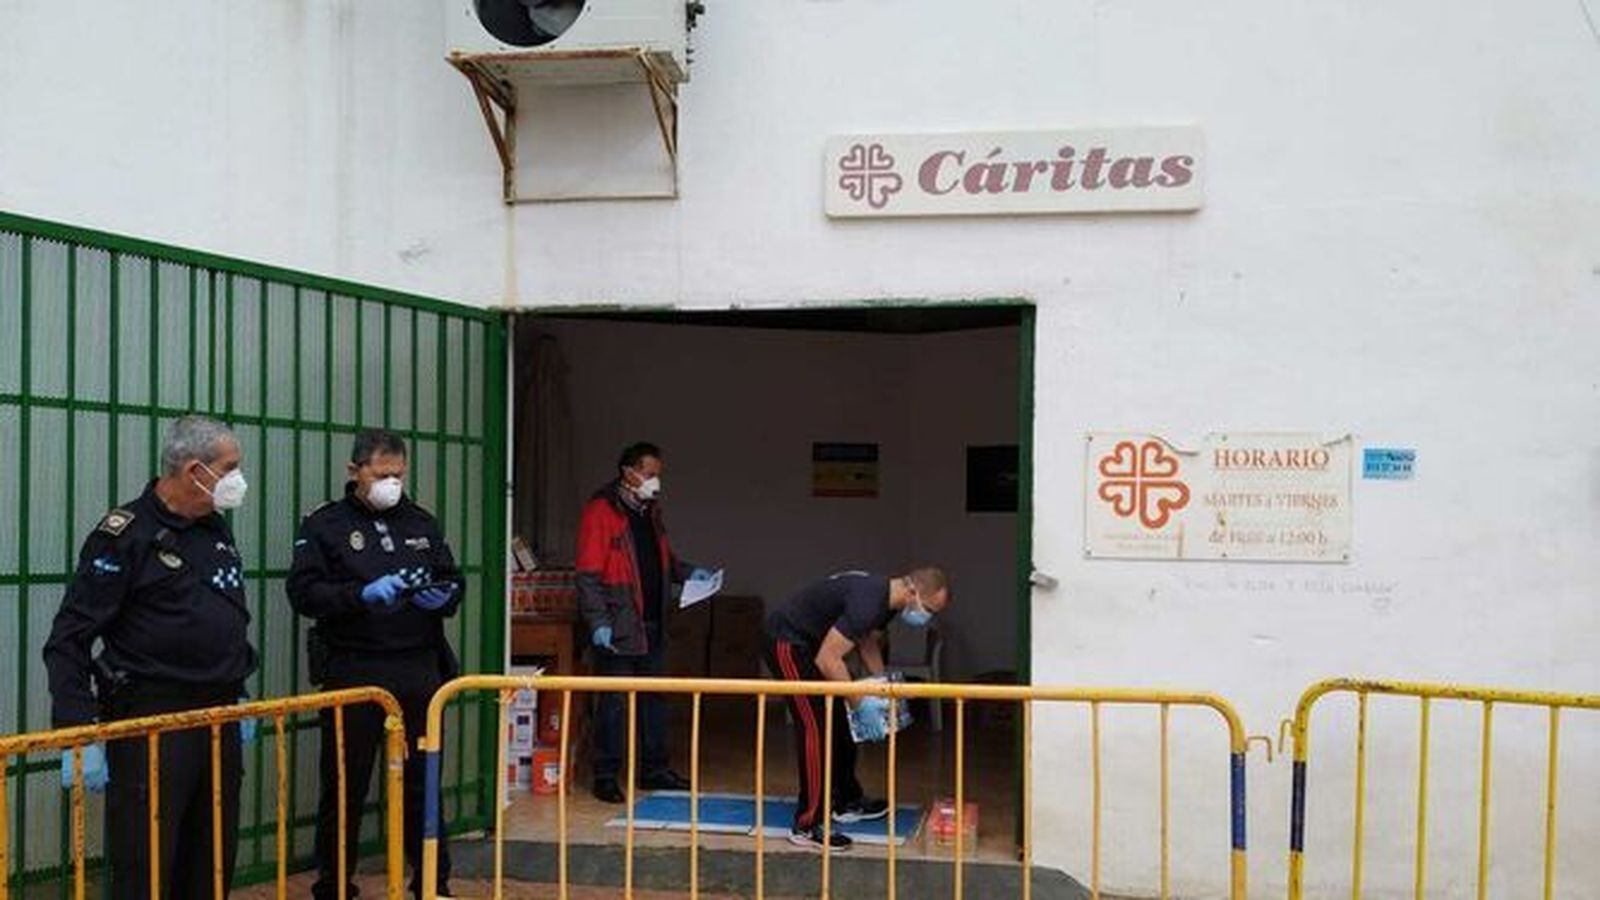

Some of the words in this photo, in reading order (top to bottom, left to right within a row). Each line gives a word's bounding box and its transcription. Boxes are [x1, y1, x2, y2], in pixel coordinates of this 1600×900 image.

[917, 146, 1194, 195] Cáritas
[1213, 448, 1330, 468] HORARIO
[1208, 529, 1226, 544] de
